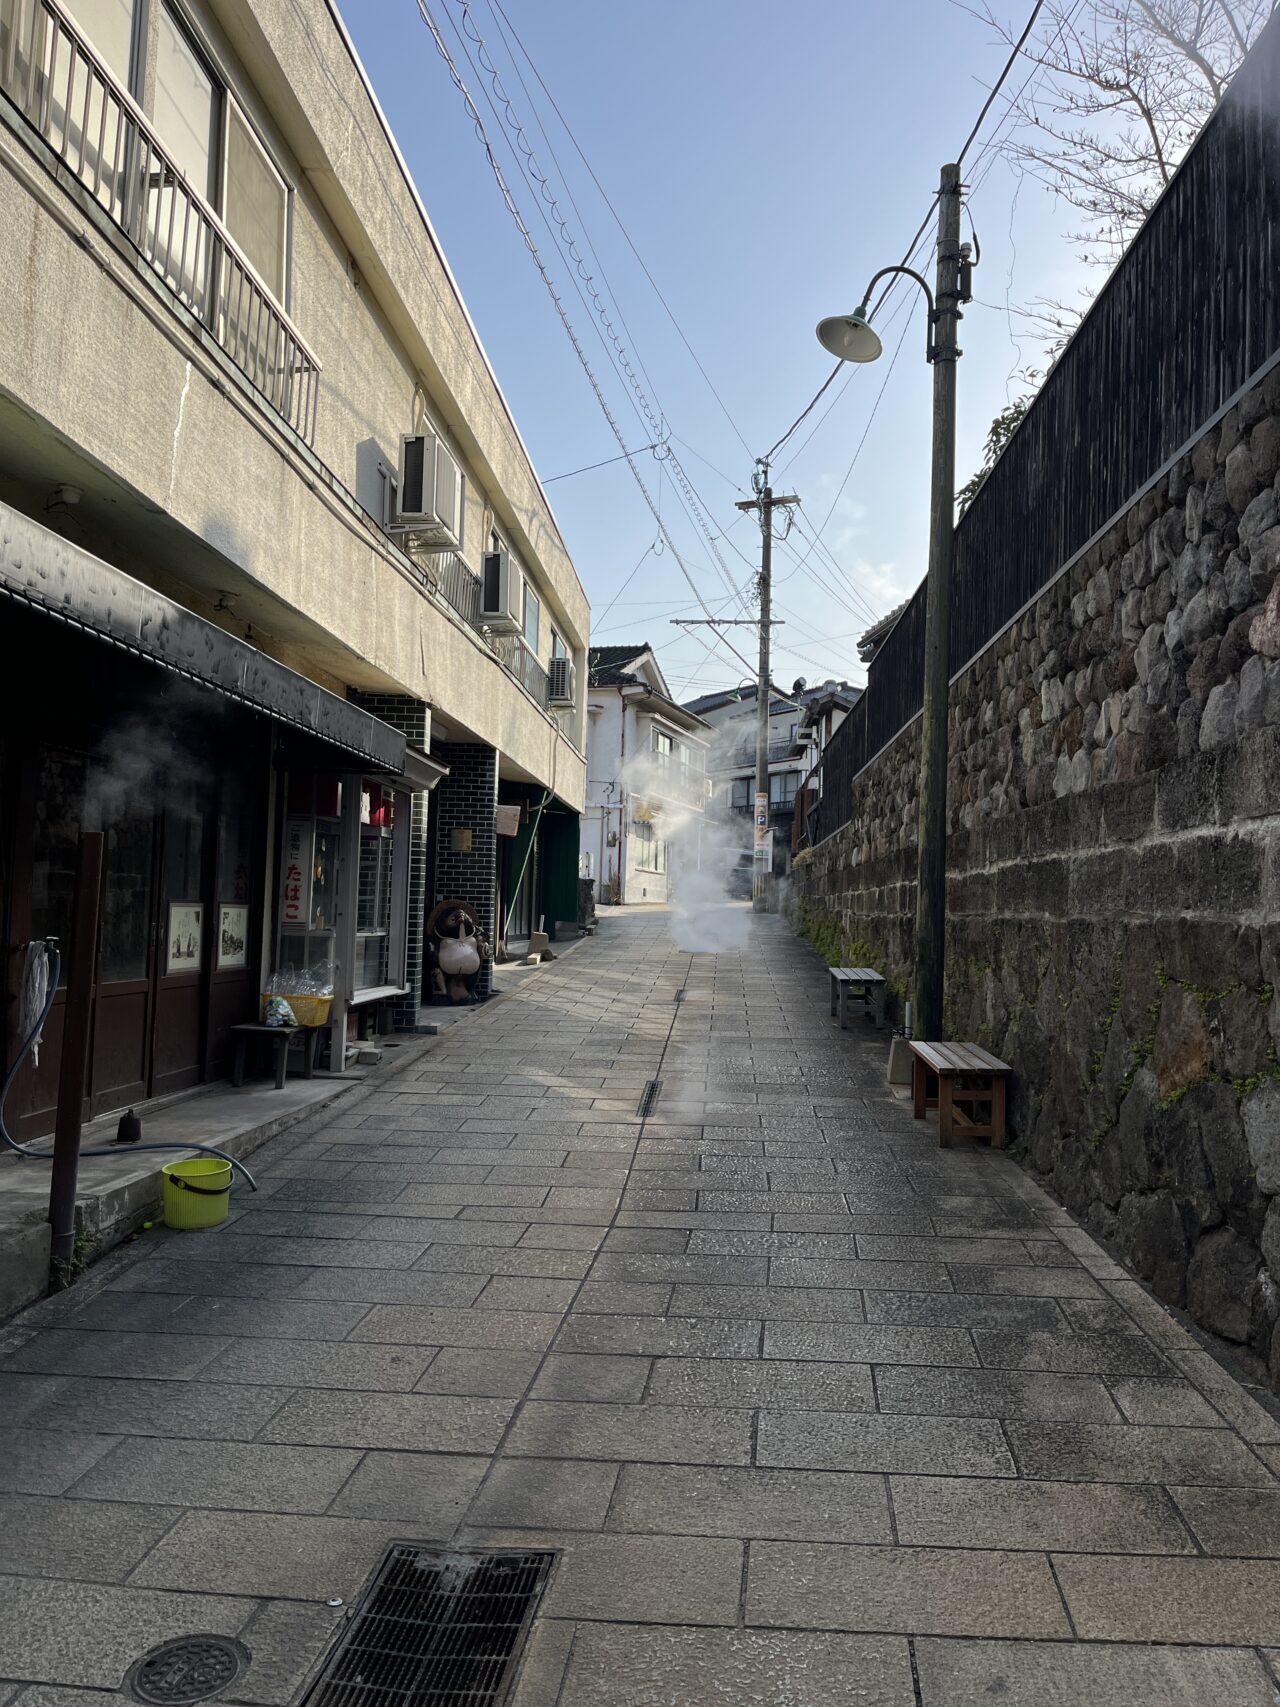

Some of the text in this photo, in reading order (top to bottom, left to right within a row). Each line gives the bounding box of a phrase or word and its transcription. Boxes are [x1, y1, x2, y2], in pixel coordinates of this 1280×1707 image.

[757, 816, 765, 825] P
[285, 864, 302, 919] たばこ
